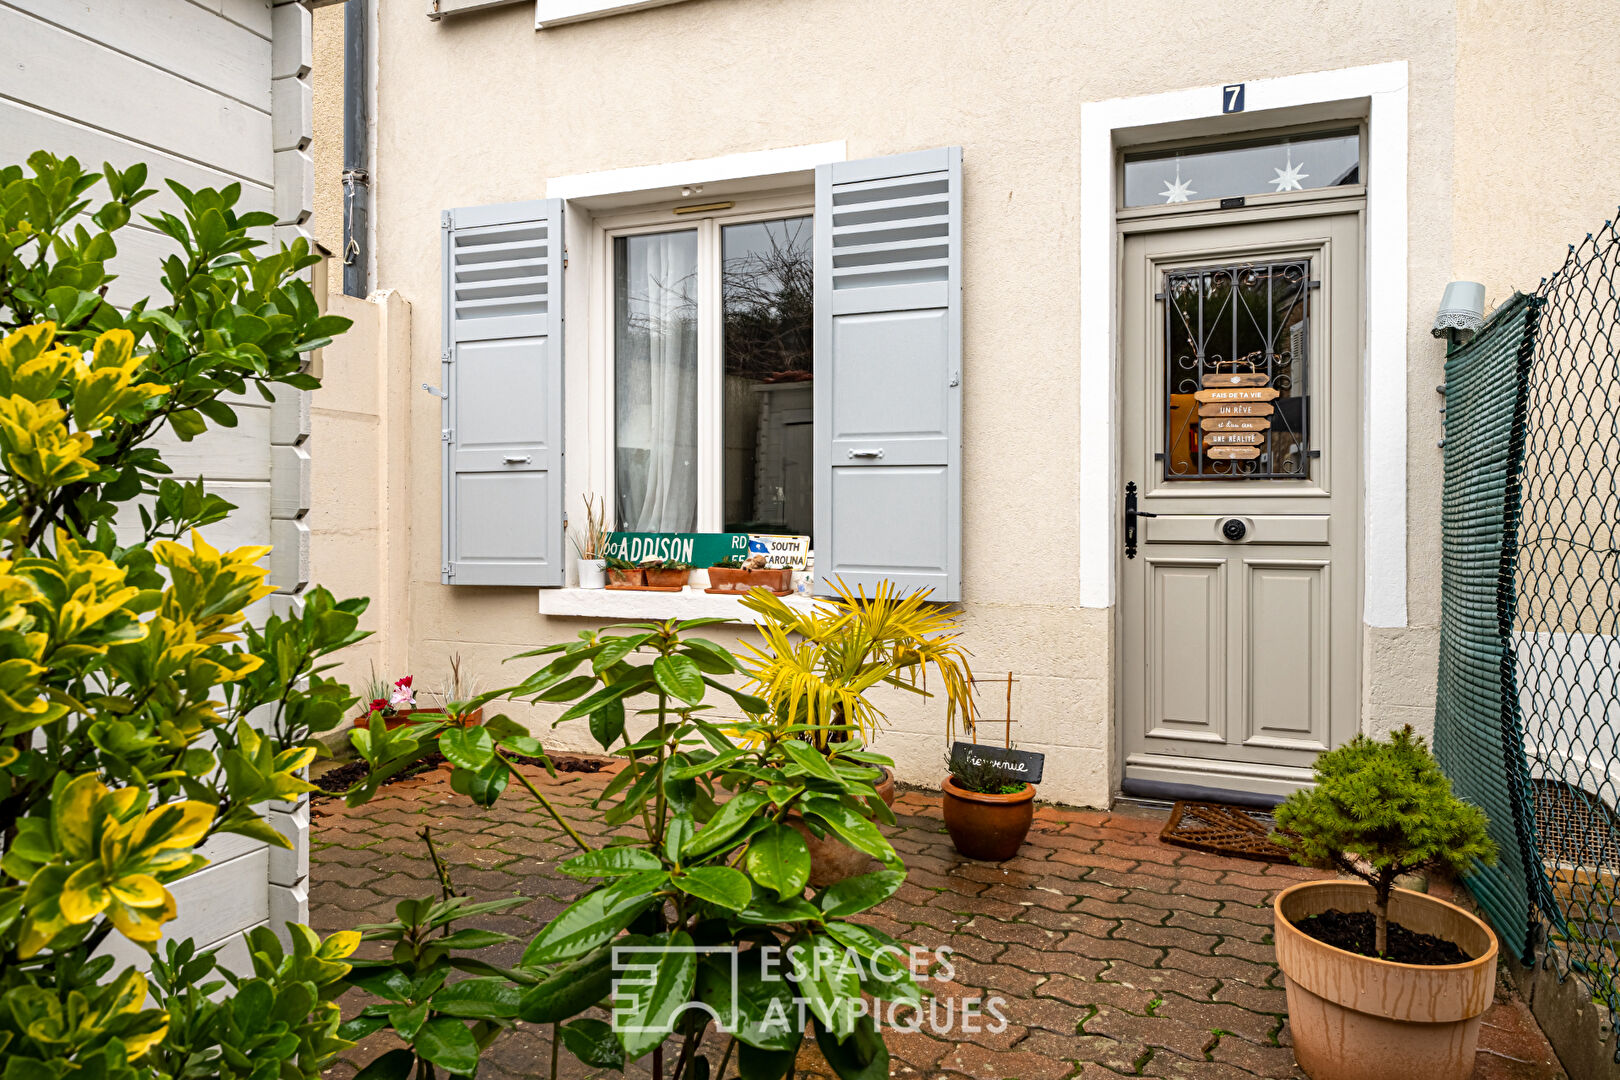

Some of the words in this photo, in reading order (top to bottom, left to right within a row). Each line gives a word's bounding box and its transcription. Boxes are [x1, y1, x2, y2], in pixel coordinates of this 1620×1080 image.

[1225, 86, 1241, 111] 7
[1233, 405, 1252, 414] RÊVE
[1212, 435, 1225, 443] UNE
[1228, 434, 1255, 443] RÉALITÉ
[617, 537, 694, 563] ADDISON
[731, 535, 747, 549] RD
[771, 541, 800, 552] SOUTH
[764, 555, 804, 566] CAROLINA
